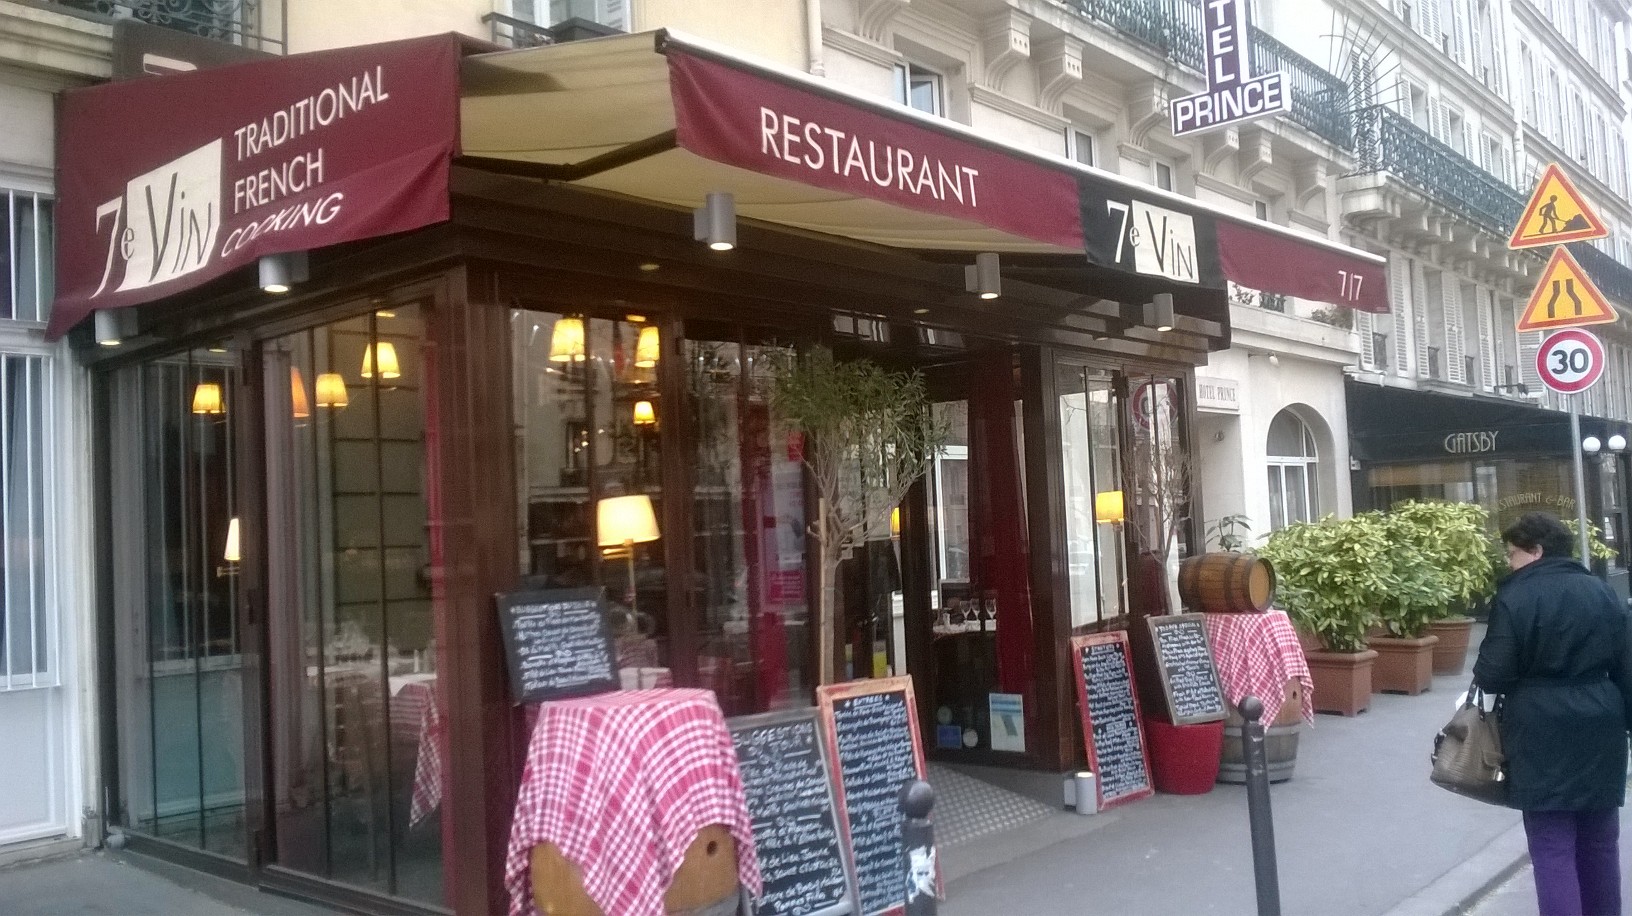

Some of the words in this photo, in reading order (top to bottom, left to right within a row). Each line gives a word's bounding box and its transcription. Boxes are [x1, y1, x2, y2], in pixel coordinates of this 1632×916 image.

[234, 65, 389, 162] TRADITIONAL
[1176, 76, 1281, 132] PRINCE
[234, 147, 324, 215] FRENCH
[760, 106, 979, 208] RESTAURANT
[220, 192, 344, 258] COOKING
[1551, 347, 1590, 375] 30
[1444, 430, 1500, 453] GATSBY
[1557, 495, 1577, 511] BAR
